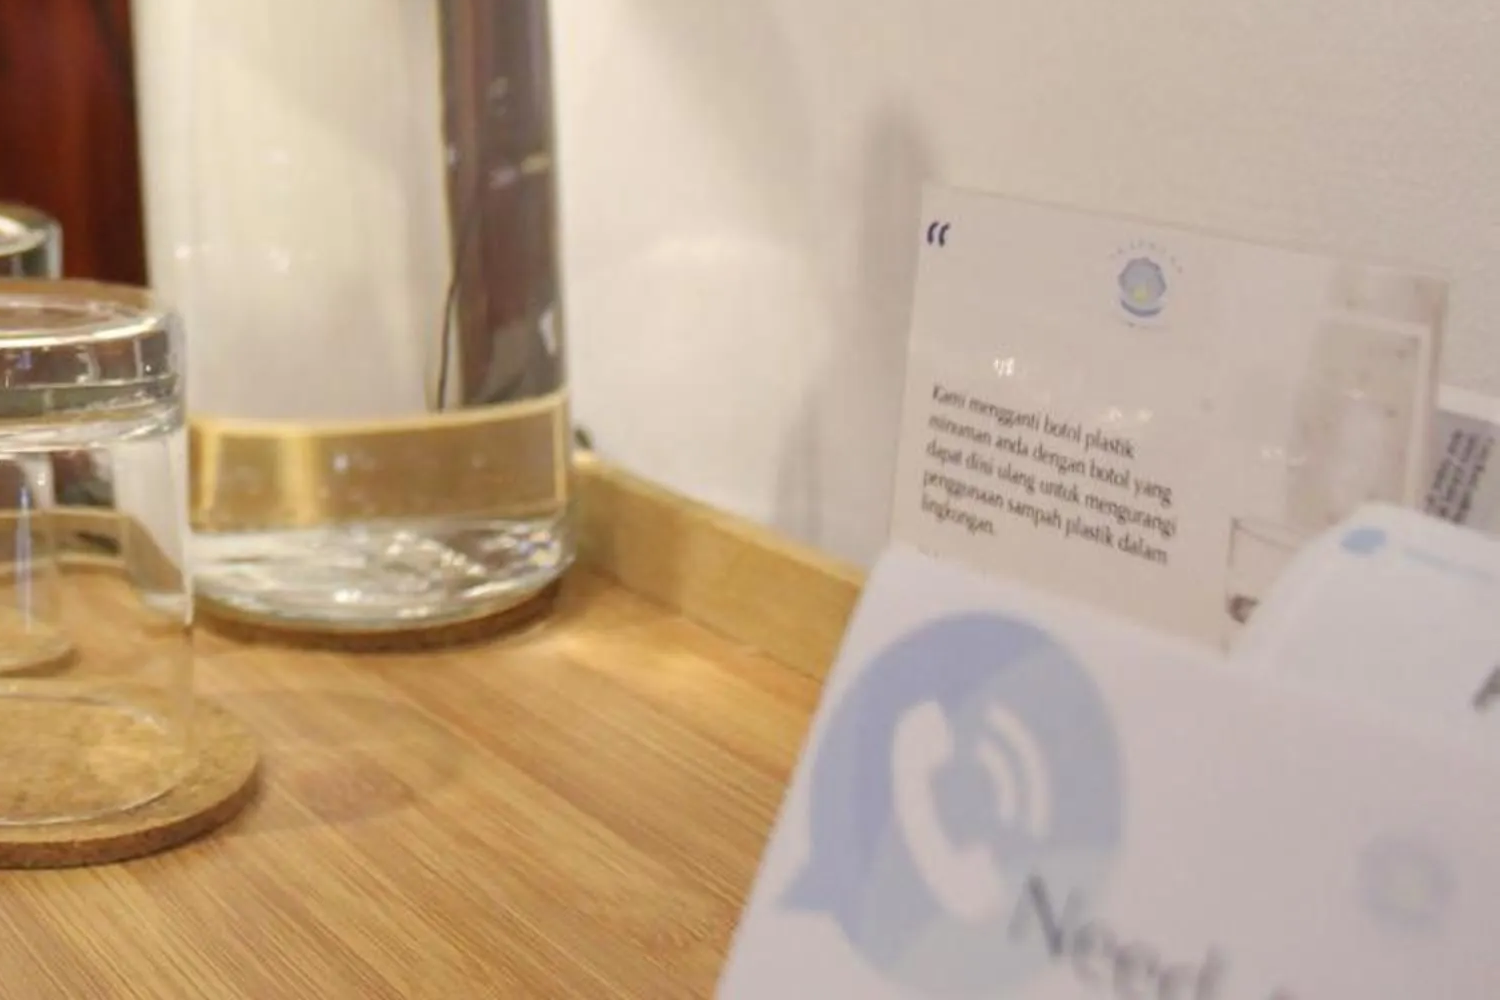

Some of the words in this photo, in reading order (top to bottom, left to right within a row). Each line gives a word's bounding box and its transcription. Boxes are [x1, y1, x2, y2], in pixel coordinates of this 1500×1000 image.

[928, 414, 992, 446] minuman
[995, 436, 1029, 457] anda
[1032, 443, 1086, 476] dengan
[1089, 458, 1130, 490] botol
[1133, 480, 1172, 508] yang
[968, 397, 1040, 431] mengganti
[1043, 413, 1082, 444] botol
[1084, 427, 1135, 460] plastik
[923, 469, 1004, 510] penggunaan
[1006, 499, 1062, 530] sampah
[1064, 515, 1115, 548] plastik
[1117, 533, 1168, 565] dalam
[926, 437, 963, 468] dapat
[997, 463, 1036, 496] ulang
[1039, 480, 1079, 504] untuk
[1084, 493, 1177, 540] mengurangi
